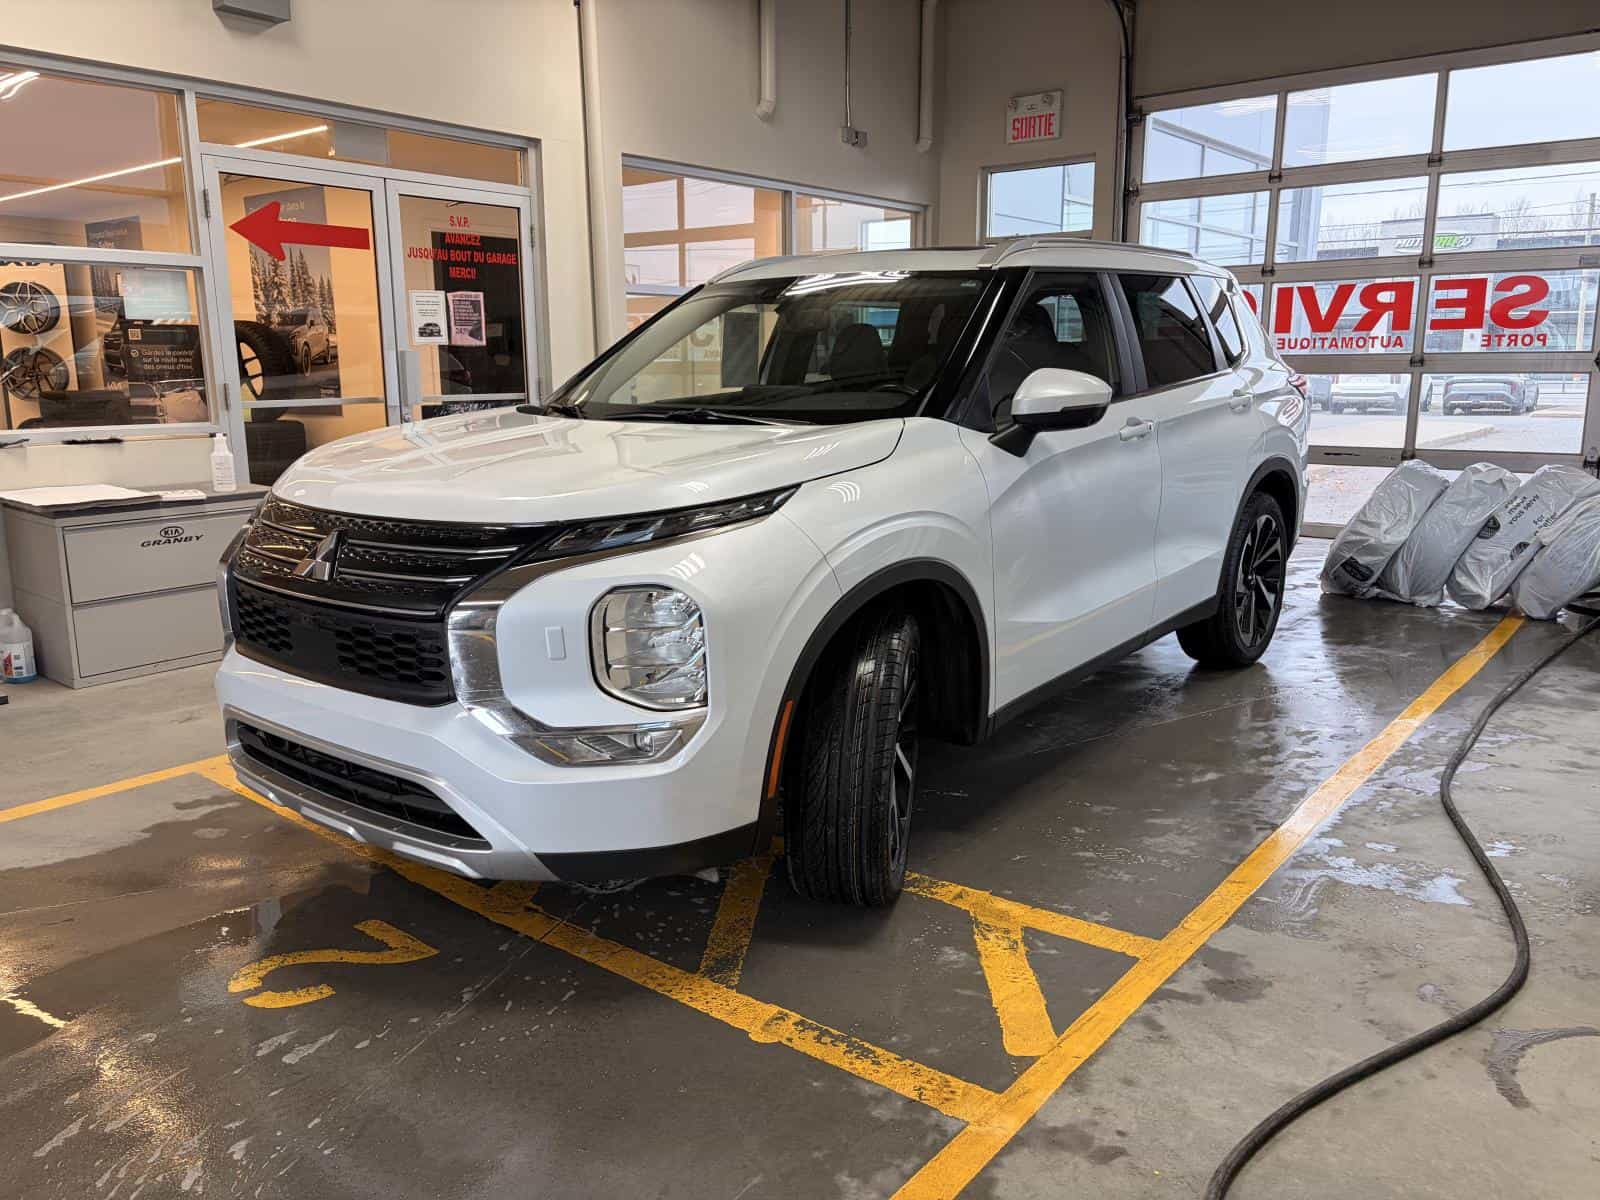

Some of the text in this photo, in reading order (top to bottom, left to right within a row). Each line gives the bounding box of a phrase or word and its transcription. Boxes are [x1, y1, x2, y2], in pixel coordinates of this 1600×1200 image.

[1012, 112, 1056, 141] SORTIE
[449, 215, 470, 228] S.V.P.
[444, 232, 481, 246] AVANCEZ
[450, 249, 472, 262] BOUT
[473, 251, 485, 263] DU
[486, 253, 517, 265] GARAGE
[1508, 510, 1525, 524] vous
[141, 534, 204, 547] GRANBY
